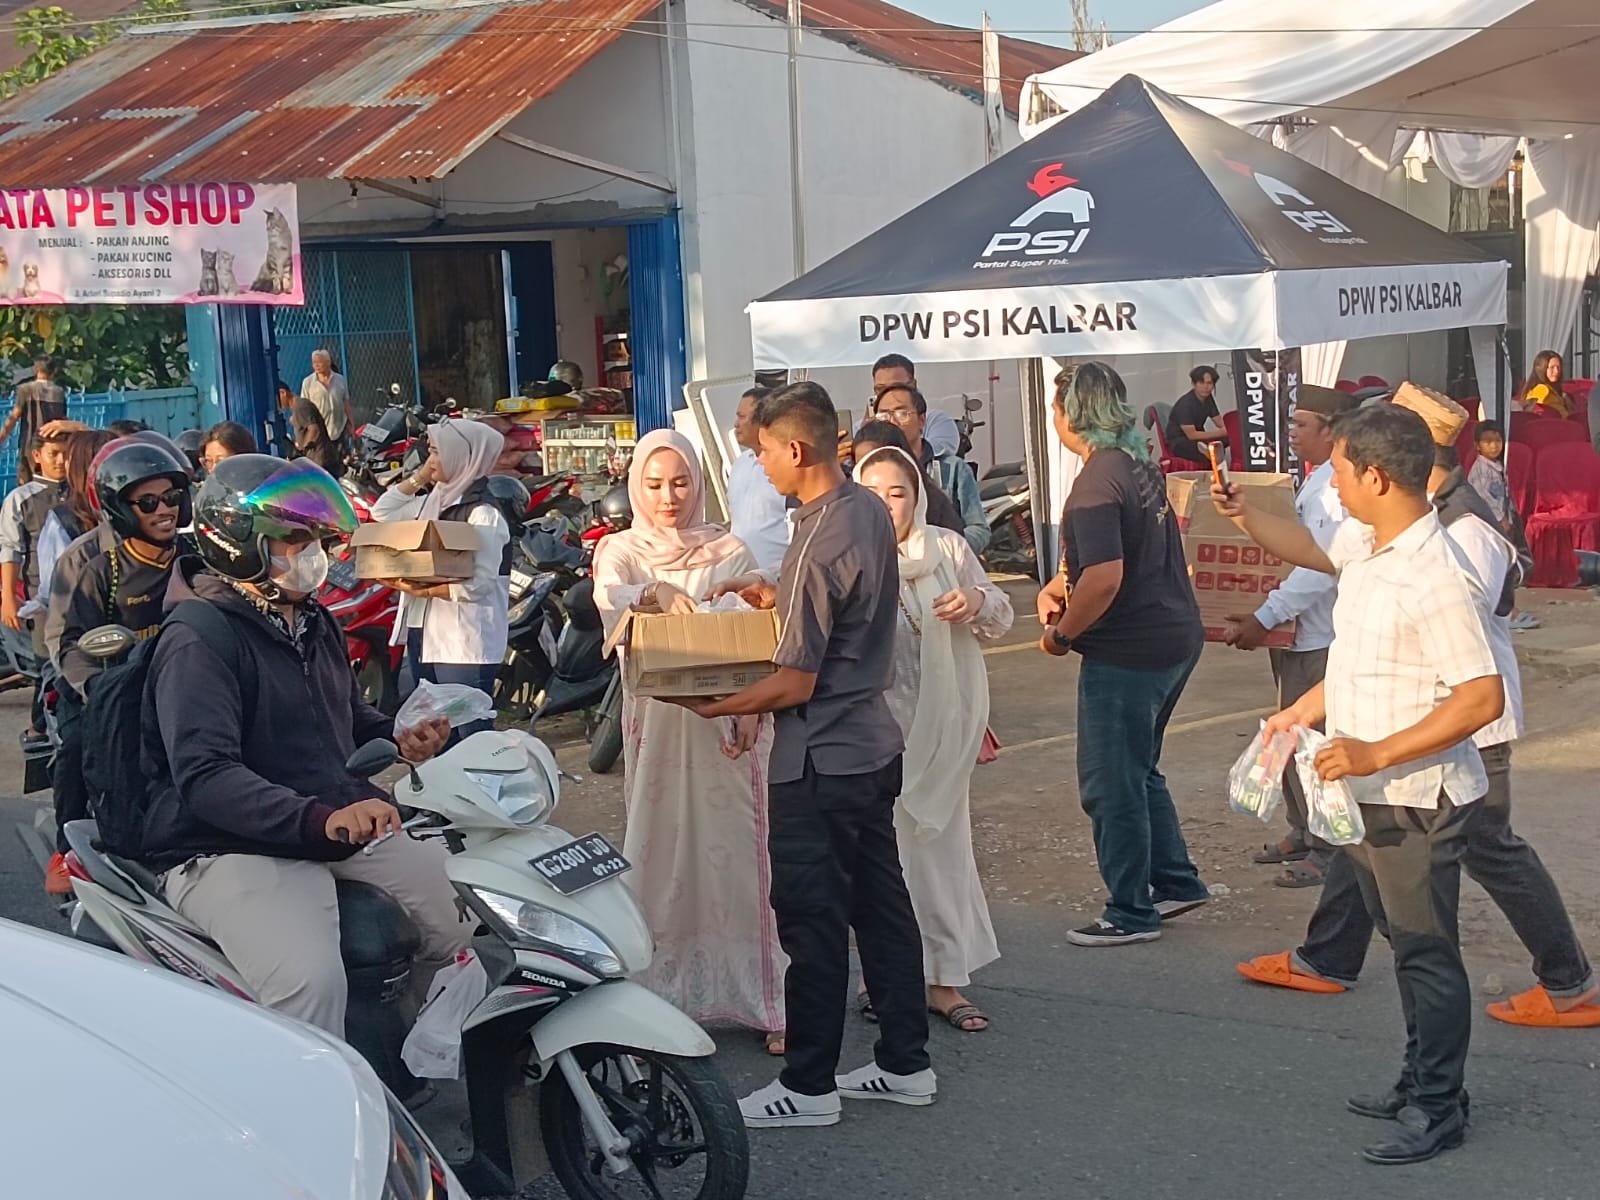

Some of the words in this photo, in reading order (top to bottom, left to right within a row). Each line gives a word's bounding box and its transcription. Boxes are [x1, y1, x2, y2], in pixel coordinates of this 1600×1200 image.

[66, 181, 255, 227] PETSHOP
[1281, 210, 1352, 233] PSI
[96, 236, 129, 247] PAKAN
[131, 236, 169, 247] ANJING
[982, 228, 1090, 257] PSI
[97, 252, 129, 263] PAKAN
[132, 252, 172, 263] KUCING
[1009, 259, 1046, 269] Super
[98, 268, 151, 279] AKSESORIS
[153, 268, 172, 279] DLL
[1339, 287, 1374, 316] DPW
[1380, 285, 1401, 314] PSI
[1405, 281, 1462, 312] KALBAR
[859, 312, 933, 342] DPW
[943, 309, 989, 338] PSI
[1002, 302, 1137, 336] KALBAR
[1245, 372, 1265, 426] DPW
[1249, 431, 1267, 465] PSI
[521, 970, 567, 988] HONDA
